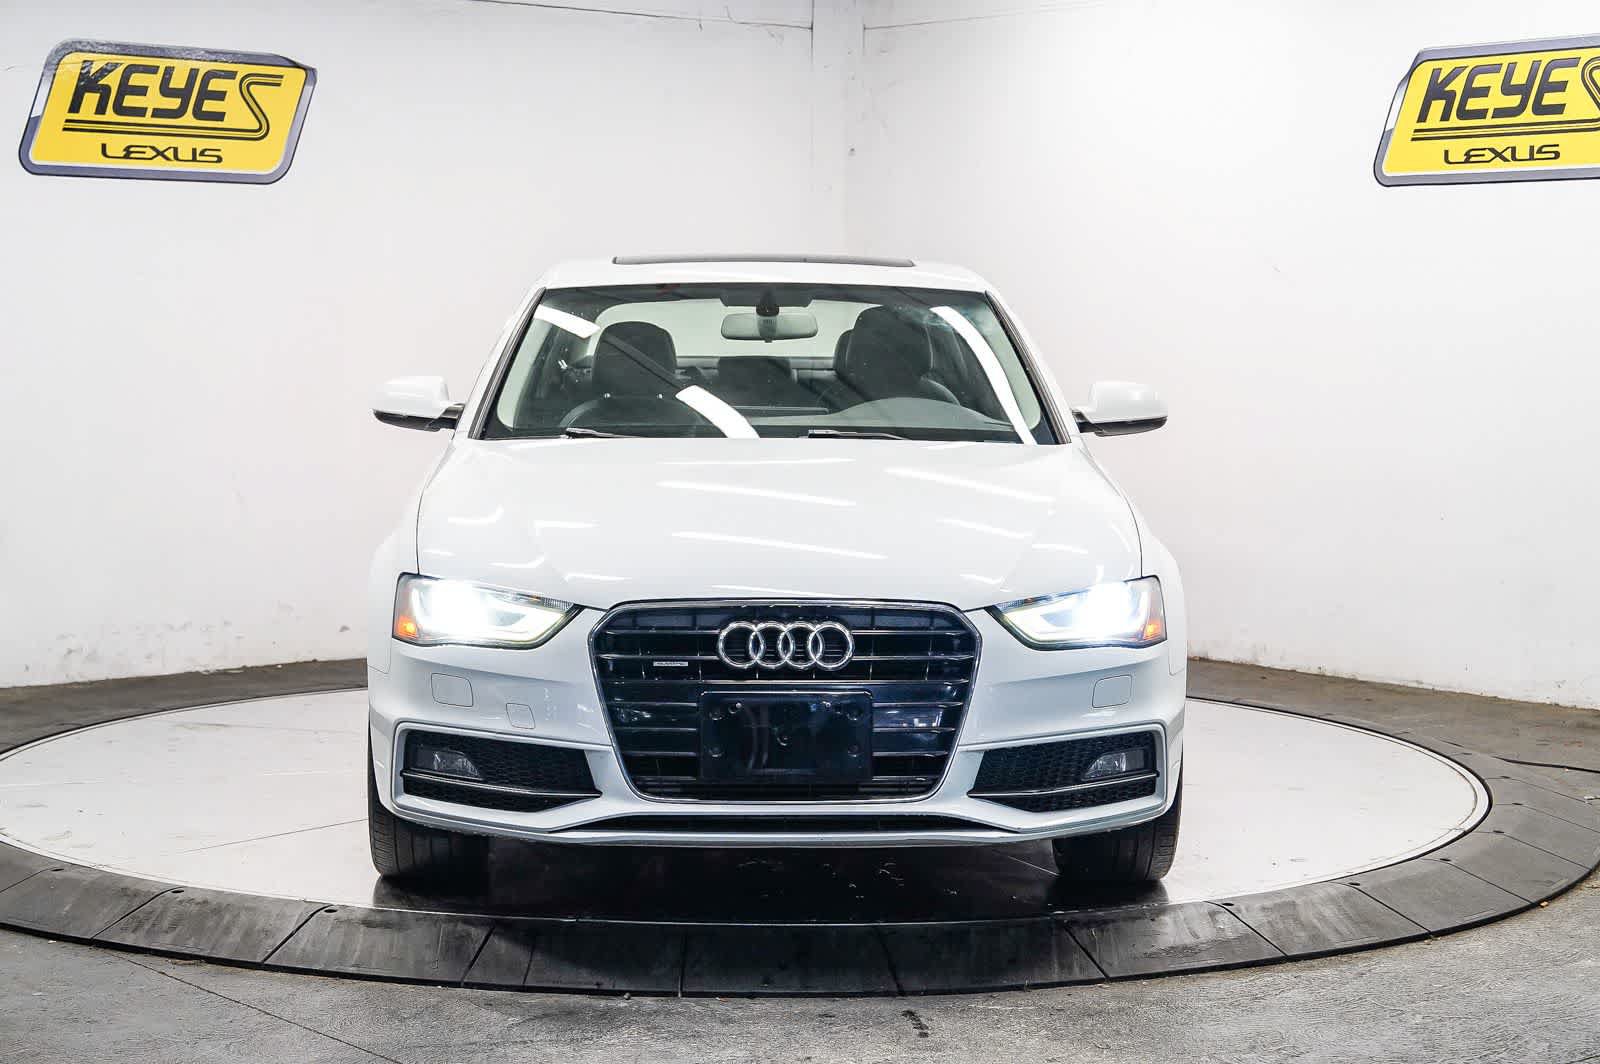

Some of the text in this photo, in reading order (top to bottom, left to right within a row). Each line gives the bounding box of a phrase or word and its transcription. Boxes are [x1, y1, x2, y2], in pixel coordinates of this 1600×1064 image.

[63, 59, 284, 141] KEYES
[101, 143, 223, 164] LEXUS
[1444, 144, 1561, 164] LEXUS
